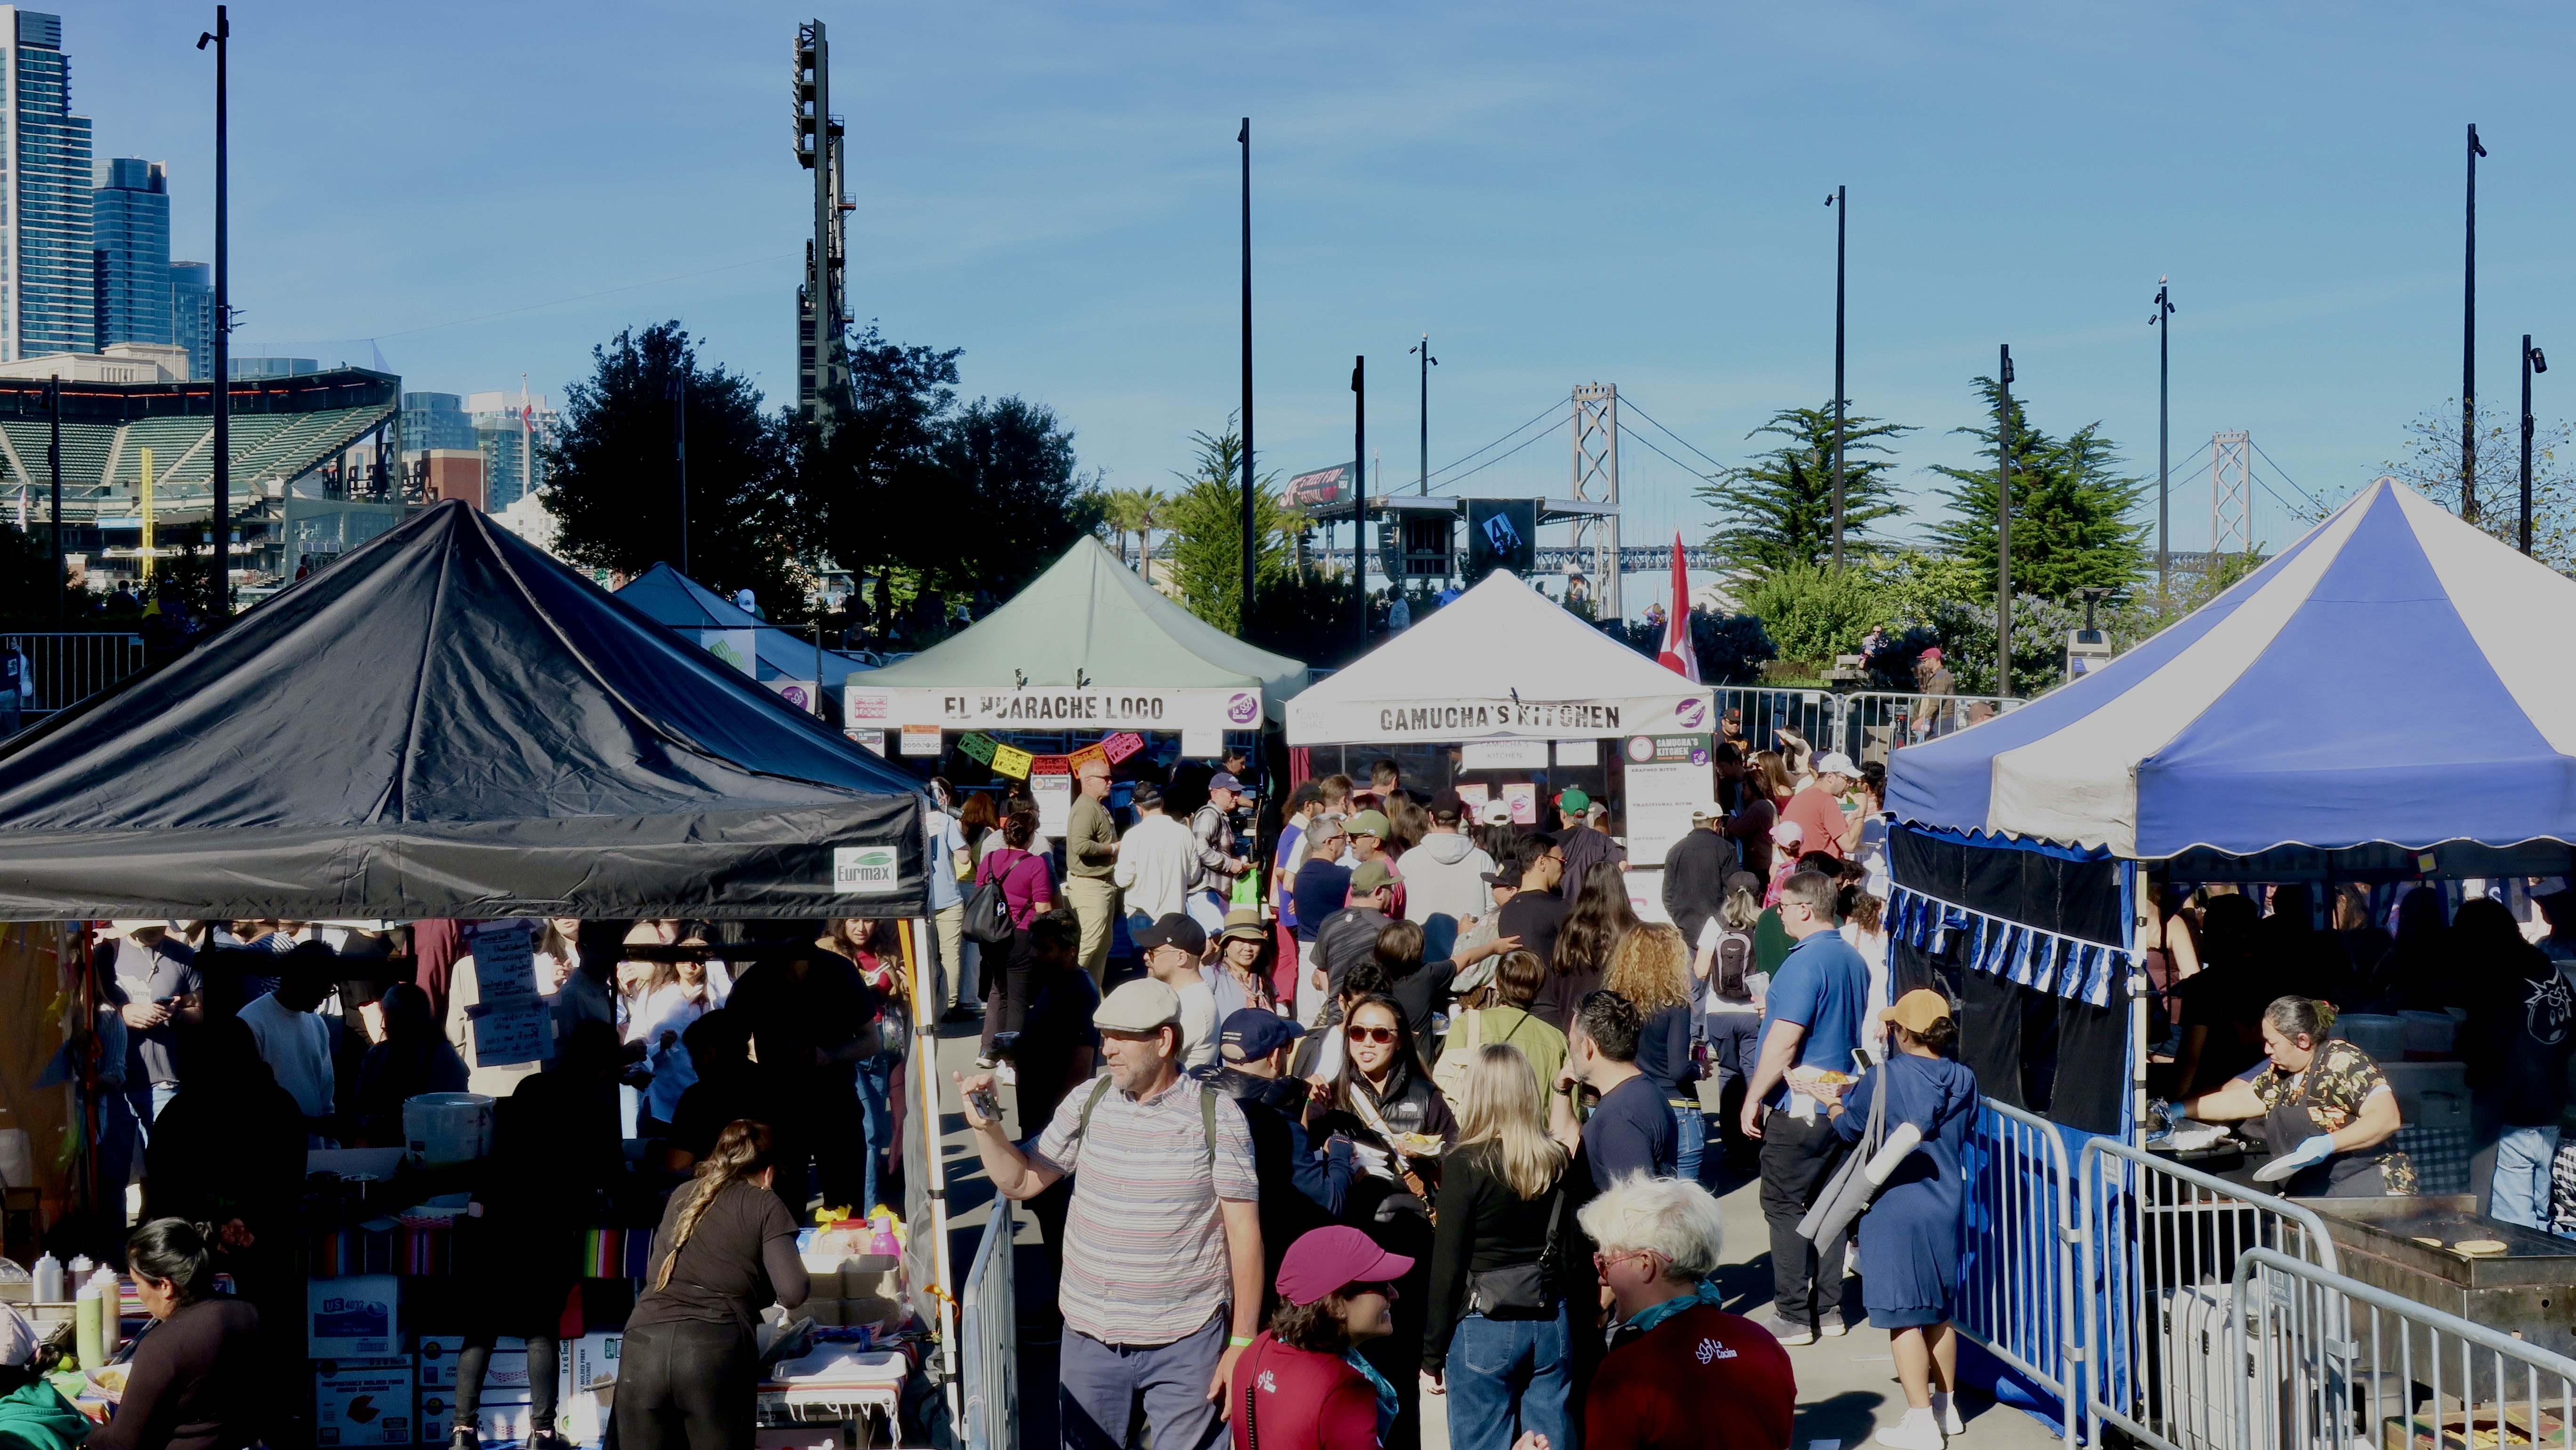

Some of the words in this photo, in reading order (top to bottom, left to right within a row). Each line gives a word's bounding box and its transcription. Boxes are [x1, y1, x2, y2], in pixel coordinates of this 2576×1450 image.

[1338, 480, 1348, 489] VISA
[944, 697, 971, 719] EL
[980, 697, 1097, 719] HUARACHE
[1105, 697, 1163, 719] LOCO
[1380, 706, 1509, 730] CAMUCHA'S
[1517, 706, 1620, 728] KITCHEN
[1656, 738, 1699, 748] CAMUCHA'S
[1656, 747, 1689, 756] KITCHEN
[837, 865, 889, 881] Eurmax
[327, 1299, 341, 1311] US
[345, 1300, 364, 1310] 4032
[1712, 1339, 1723, 1349] La
[1716, 1348, 1737, 1359] Cocina
